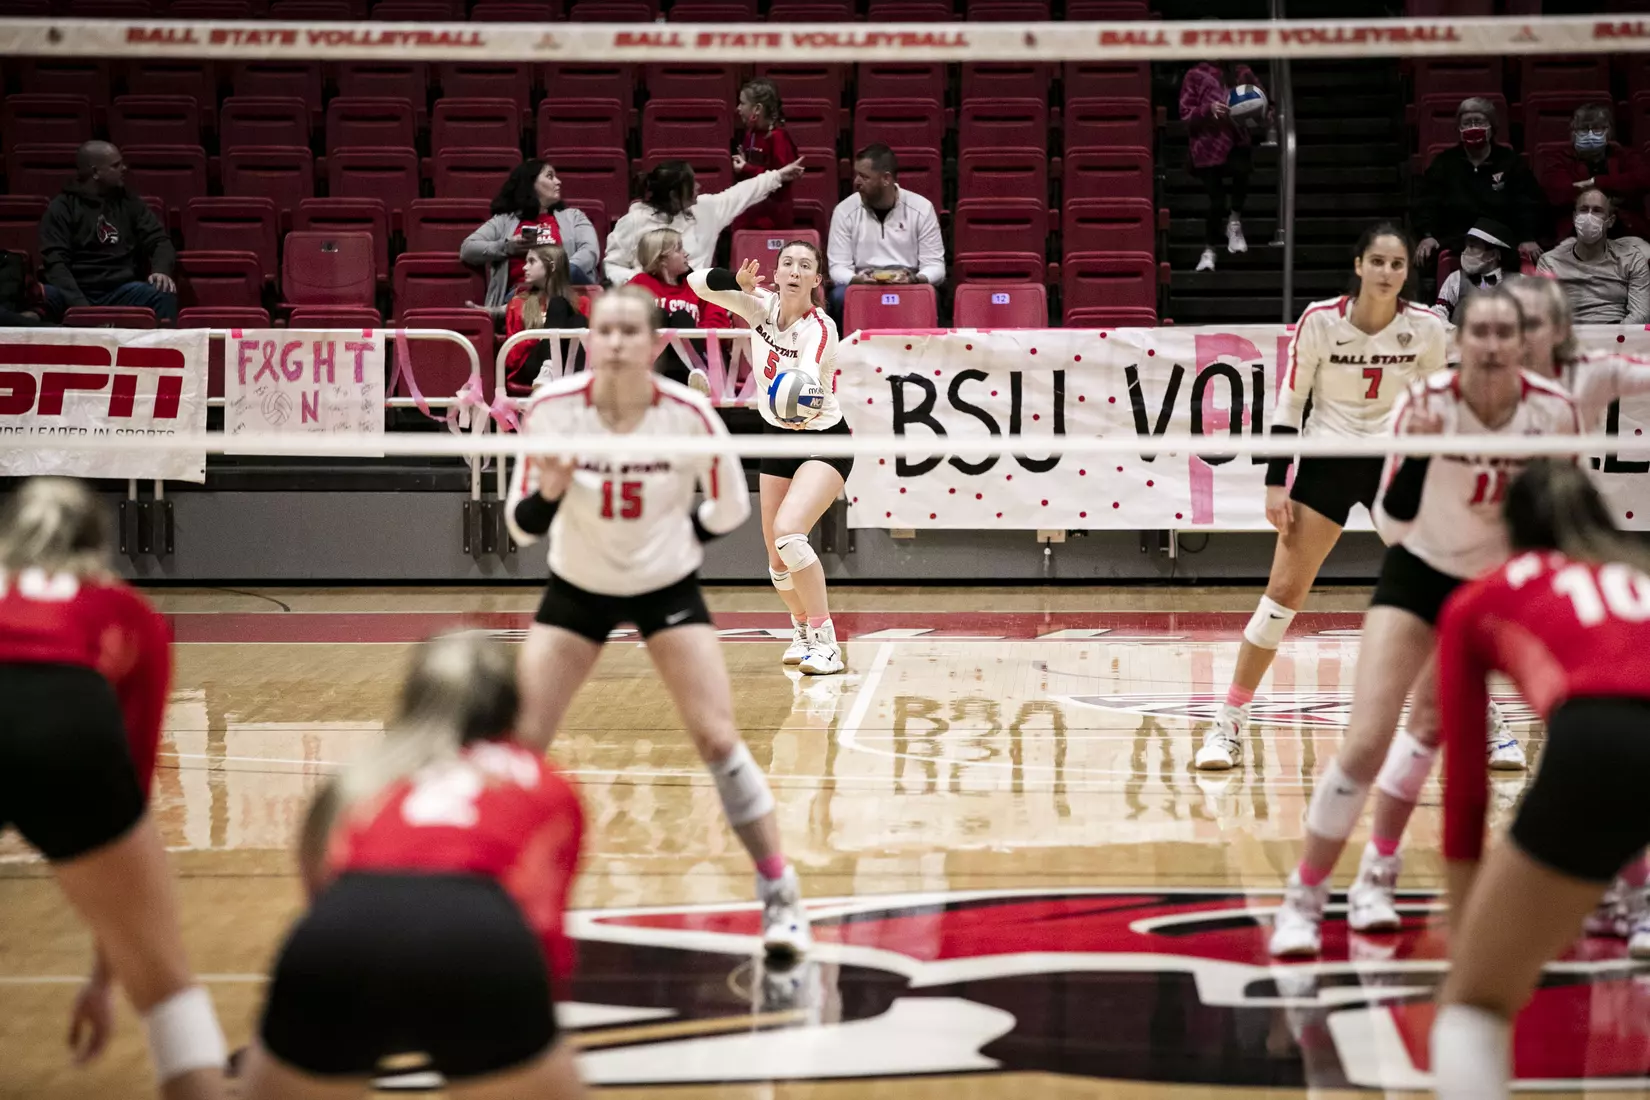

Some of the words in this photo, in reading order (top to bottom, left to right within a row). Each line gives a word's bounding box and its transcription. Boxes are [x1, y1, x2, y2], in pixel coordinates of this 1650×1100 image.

[126, 27, 199, 44] BALL
[209, 29, 298, 45] STATE
[306, 30, 486, 47] VOLLEYBALL
[614, 32, 686, 47] BALL
[696, 32, 782, 47] STATE
[792, 32, 969, 47] VOLLEYBALL
[1099, 30, 1171, 45] BALL
[1181, 29, 1269, 46] STATE
[1279, 26, 1461, 44] VOLLEYBALL
[755, 324, 777, 348] BALL
[774, 344, 799, 359] STATE
[763, 349, 780, 380] 5
[1329, 354, 1367, 365] BALL
[1370, 354, 1417, 364] STATE
[1362, 367, 1383, 399] 7
[886, 368, 1066, 478] BSU
[600, 480, 644, 520] 15
[1551, 561, 1650, 629] 10
